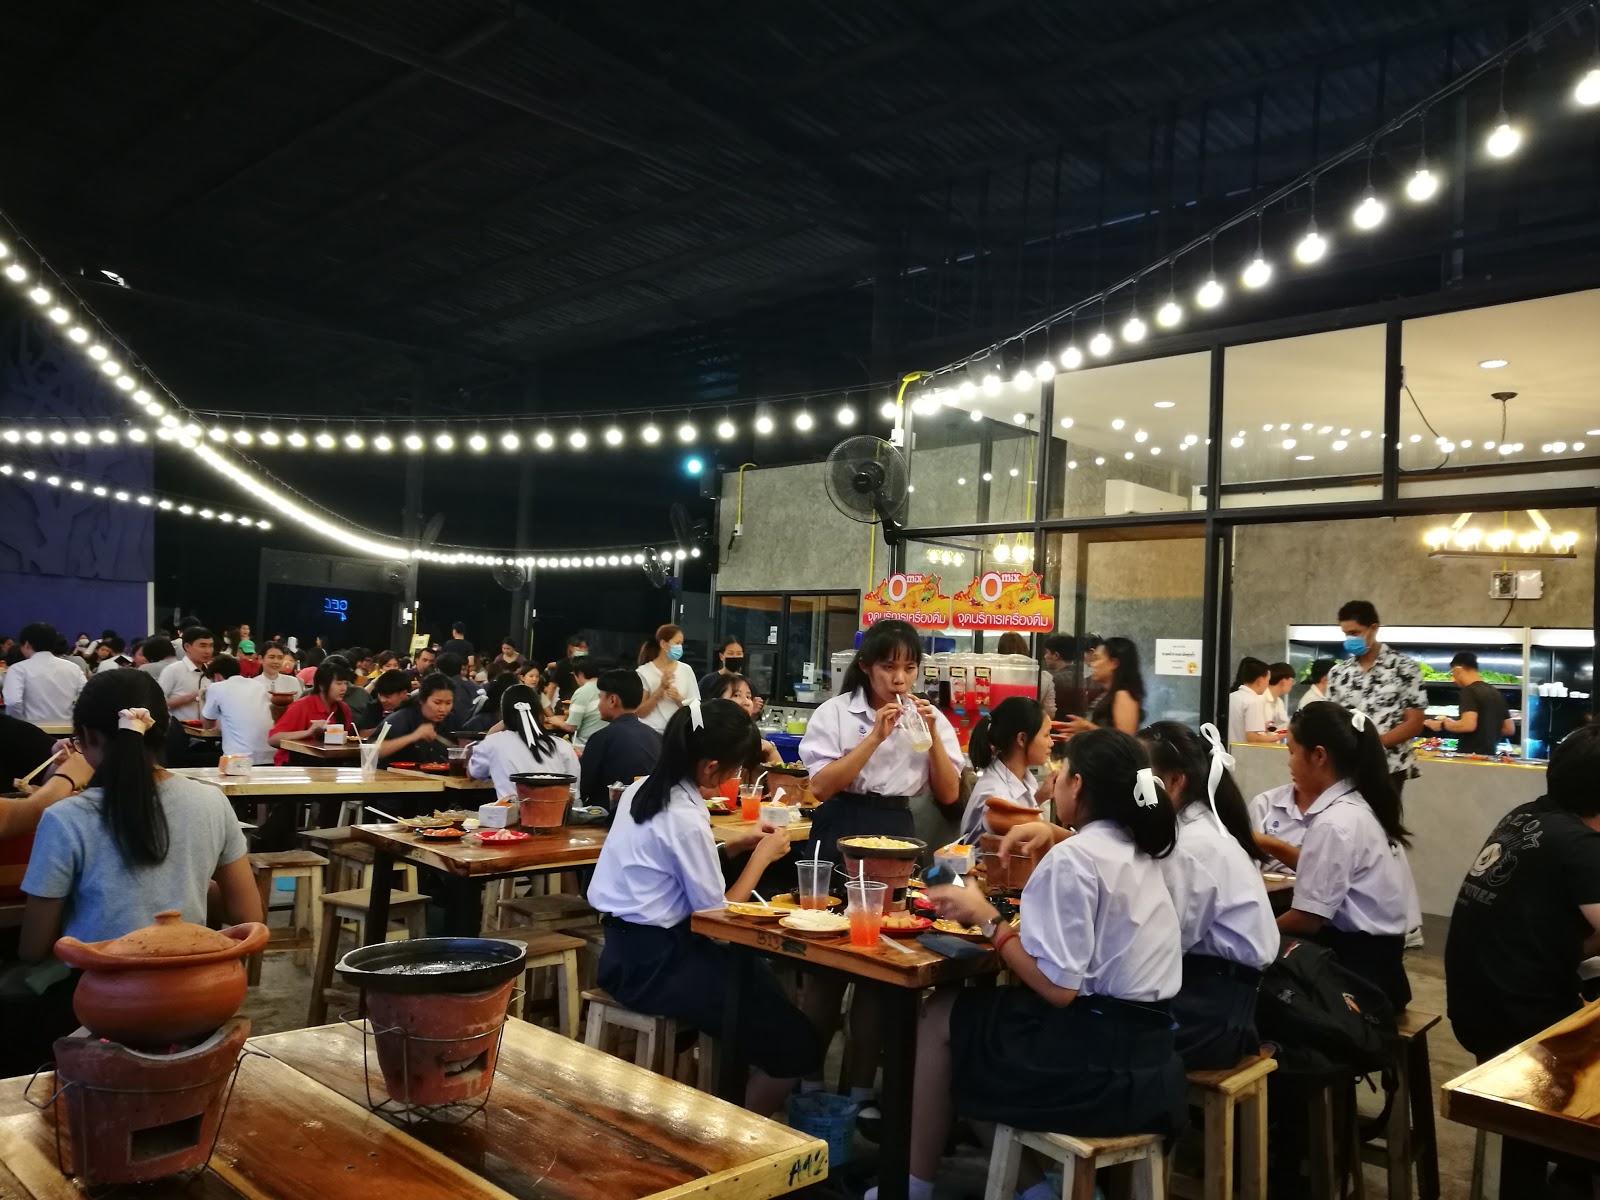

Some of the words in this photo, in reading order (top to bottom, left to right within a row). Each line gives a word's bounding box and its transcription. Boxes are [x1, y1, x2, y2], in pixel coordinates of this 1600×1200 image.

[957, 609, 1049, 627] จุดบริการเครื่องดื่ม
